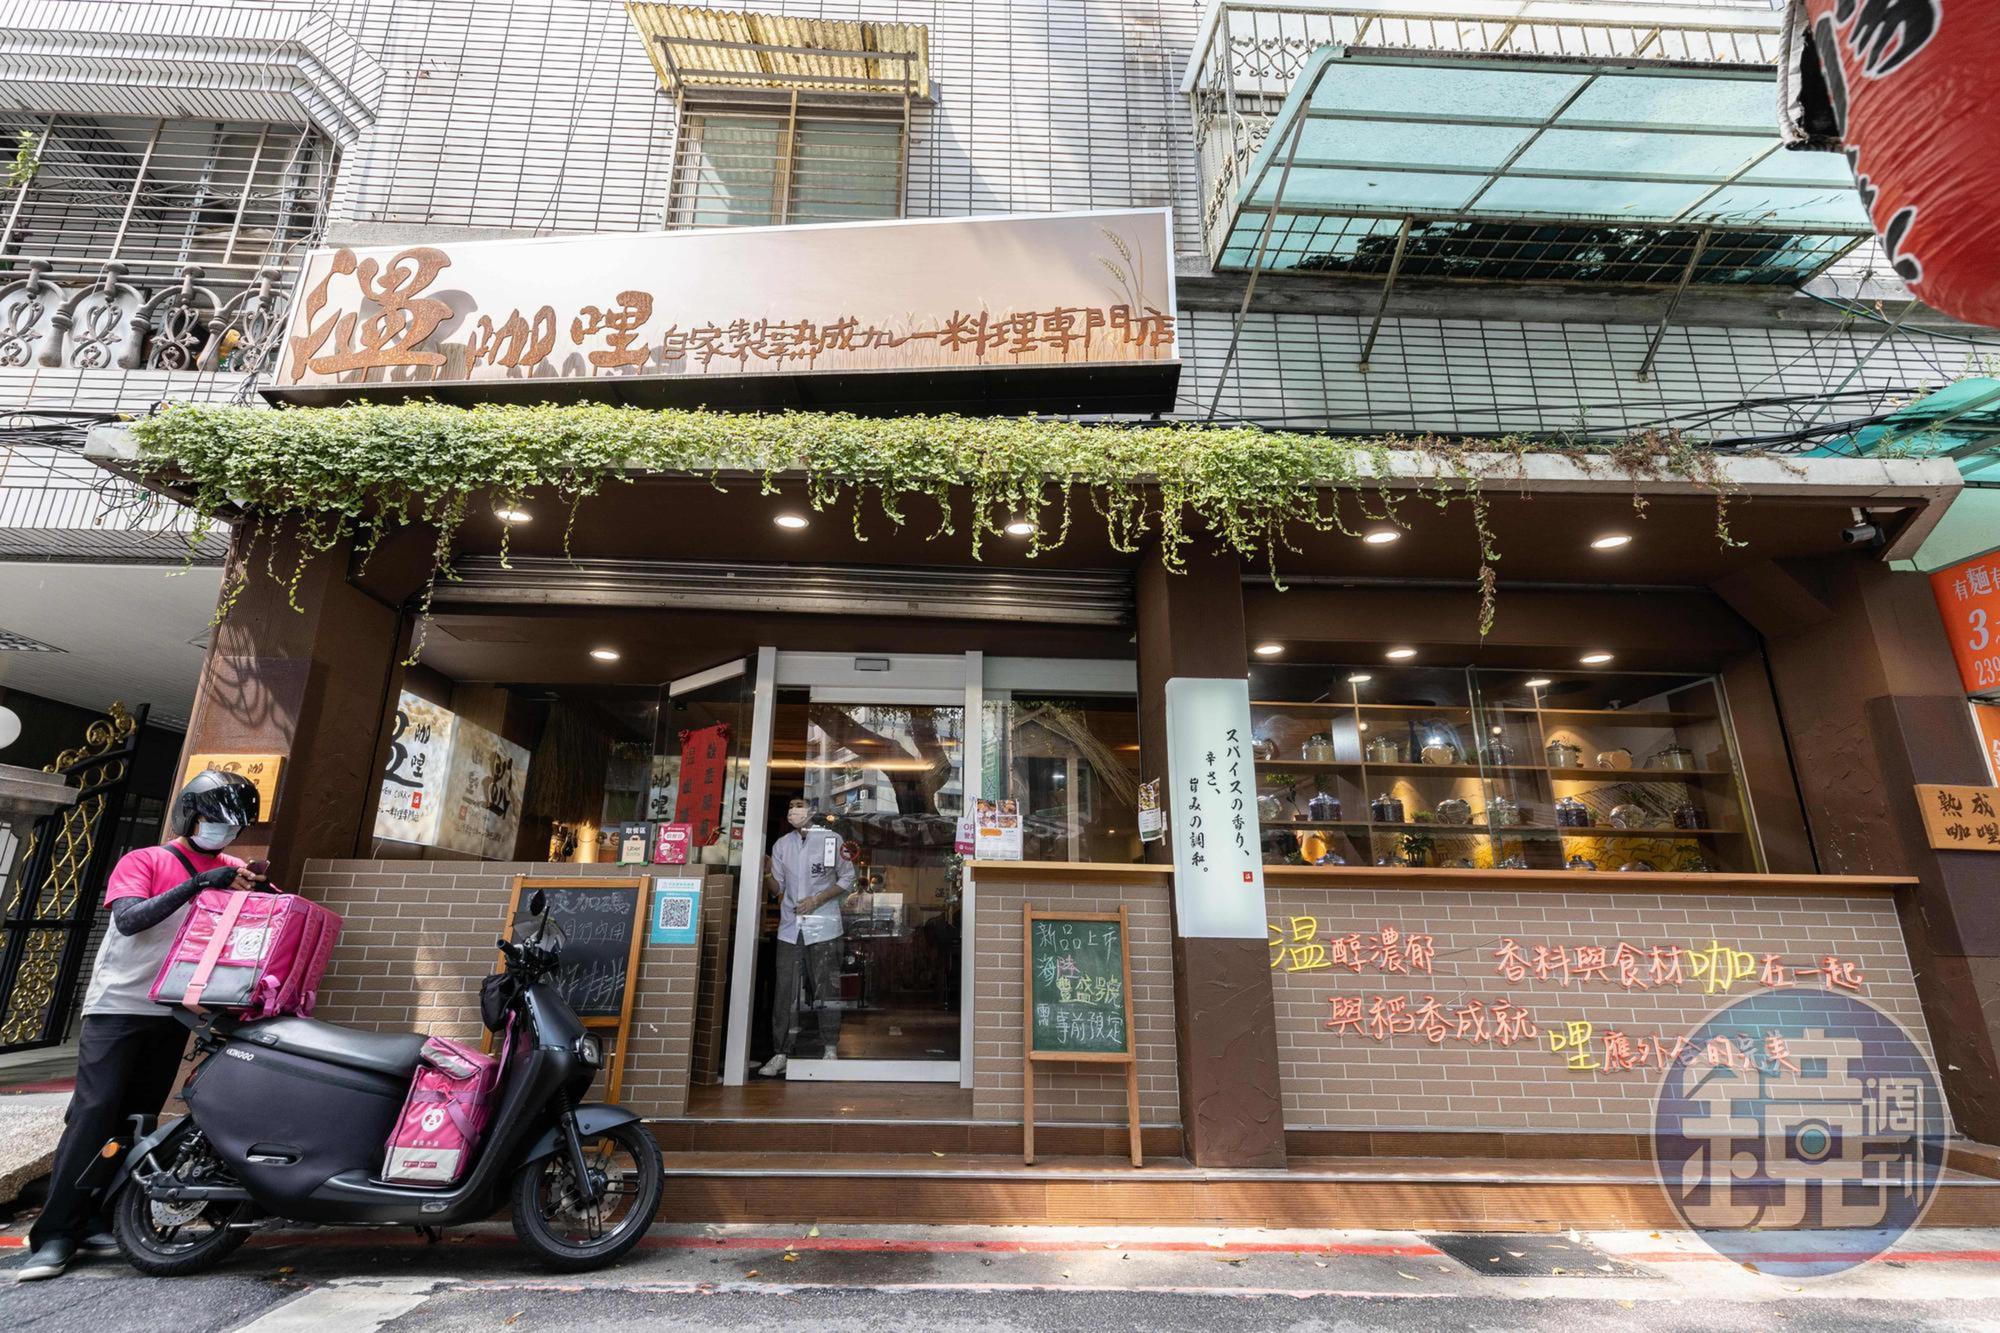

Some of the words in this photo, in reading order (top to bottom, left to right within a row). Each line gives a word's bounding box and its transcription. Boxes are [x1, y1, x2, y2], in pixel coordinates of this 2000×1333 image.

[1937, 790, 1996, 818] 熟成
[1945, 822, 2000, 845] 咖哩
[1036, 923, 1118, 965] 新品上市
